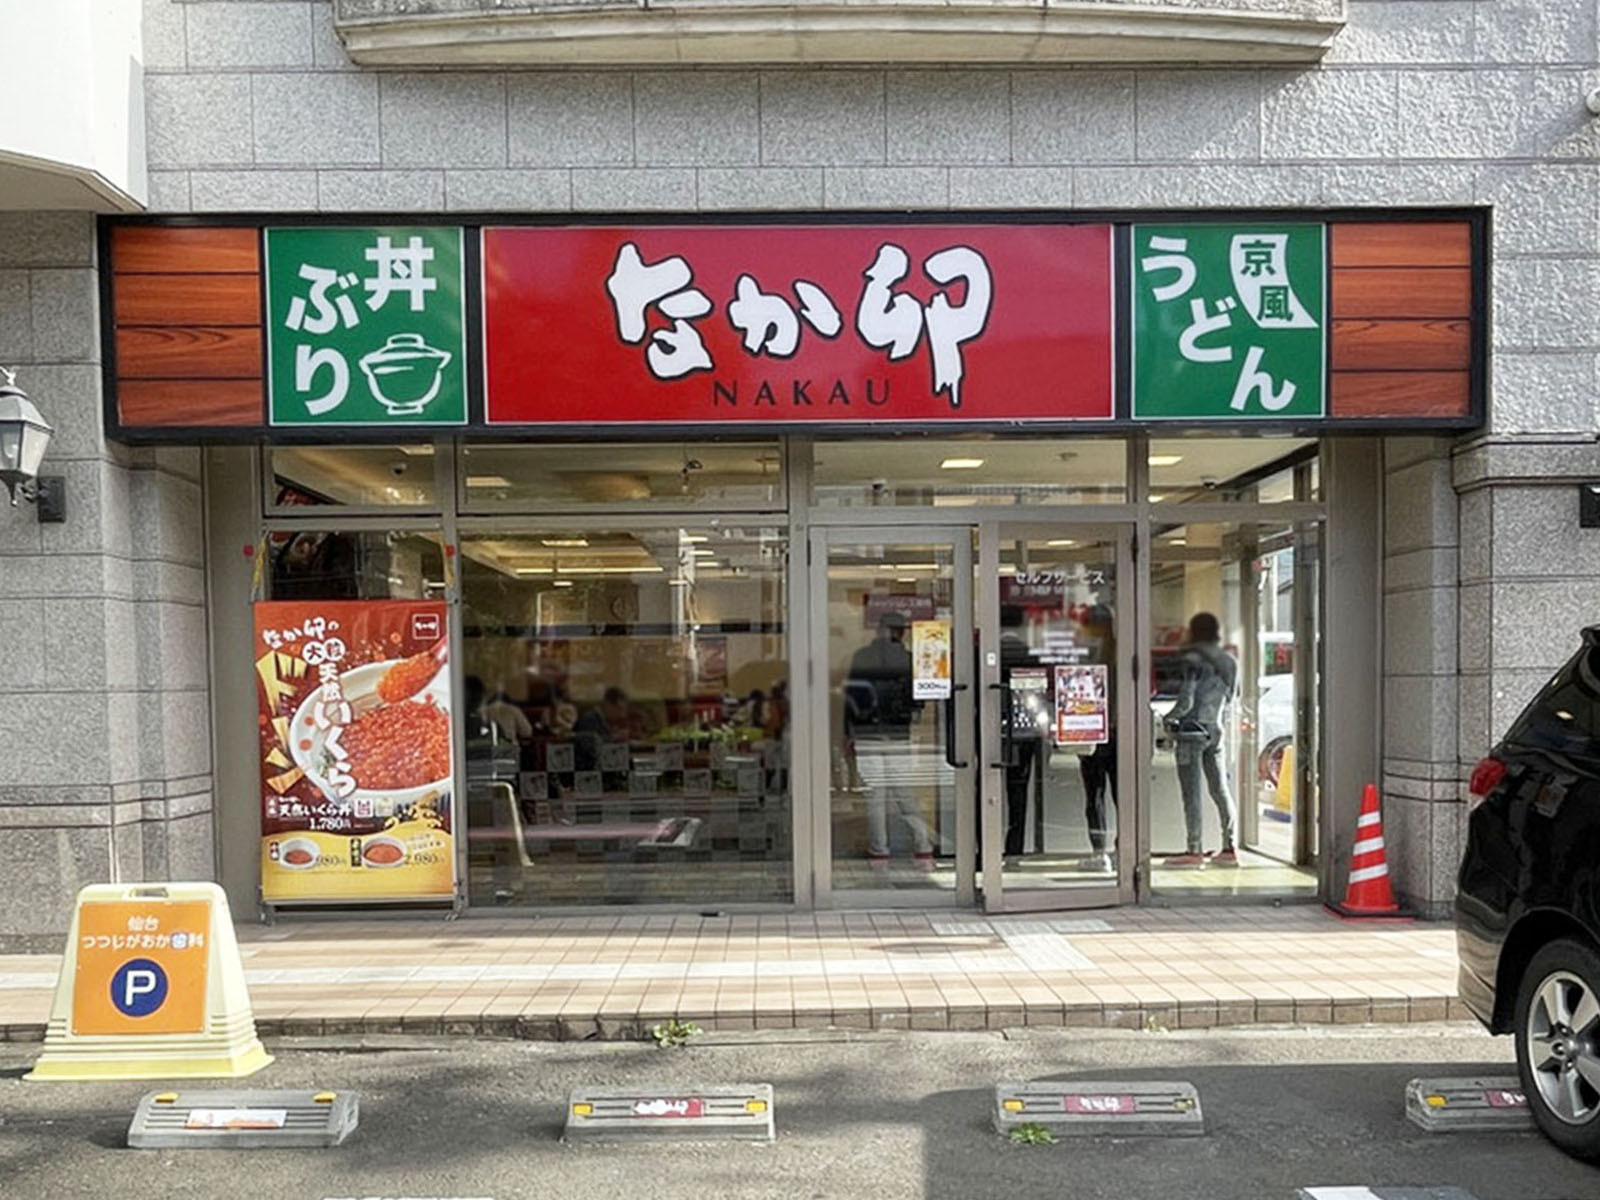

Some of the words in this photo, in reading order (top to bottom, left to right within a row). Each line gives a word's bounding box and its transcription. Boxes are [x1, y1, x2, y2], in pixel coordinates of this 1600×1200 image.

[1239, 239, 1294, 322] 京風
[606, 241, 993, 408] なか卯
[1141, 235, 1297, 411] うどん
[712, 379, 891, 407] NAKAU
[127, 915, 159, 931] 仙台
[125, 970, 156, 1006] P
